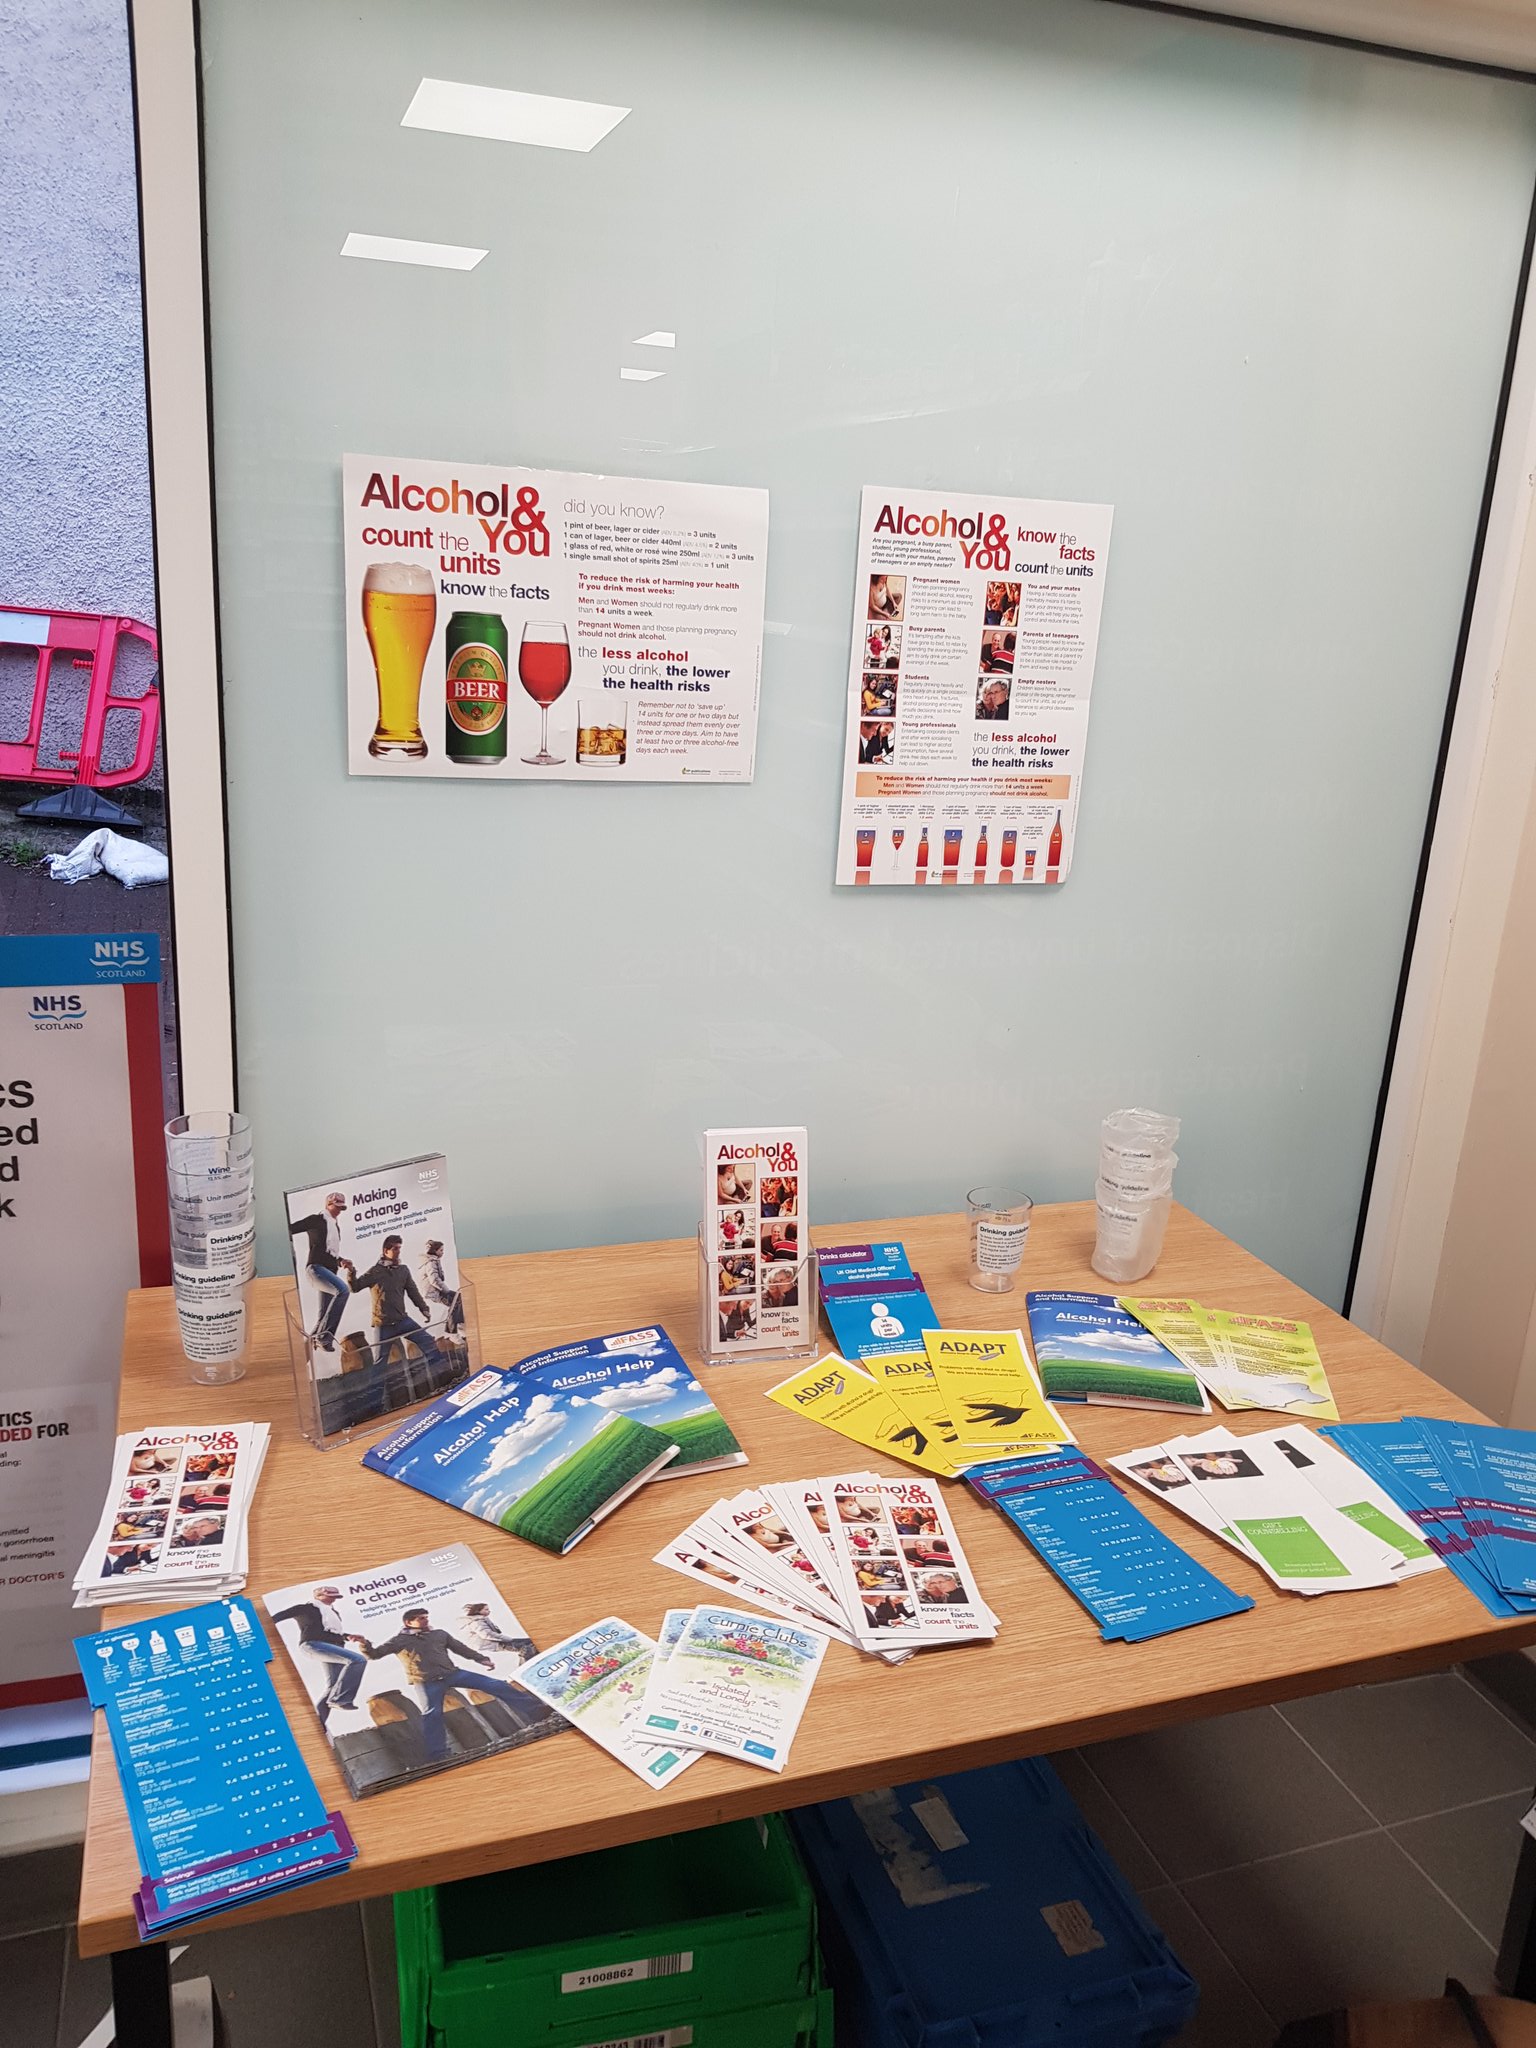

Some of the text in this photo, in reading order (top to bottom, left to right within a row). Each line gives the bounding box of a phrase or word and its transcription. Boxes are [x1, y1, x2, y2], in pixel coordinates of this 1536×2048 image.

[361, 473, 550, 533] Alcohol &
[564, 499, 665, 519] did you know?
[570, 523, 583, 532] pint
[586, 524, 593, 532] of
[595, 526, 612, 534] beer,
[614, 527, 631, 536] lager
[643, 528, 659, 537] cider
[700, 533, 717, 541] units
[874, 505, 1010, 551] Alcohol &
[1017, 526, 1077, 546] know the
[362, 527, 469, 552] count the
[478, 518, 550, 556] You
[959, 541, 1011, 571] You
[1059, 545, 1095, 561] facts
[440, 552, 501, 575] units
[1015, 562, 1094, 577] count the units
[441, 580, 549, 600] know the facts
[579, 573, 740, 590] To reduce the risk of harming your health
[586, 584, 600, 592] you
[603, 584, 623, 592] drink
[626, 585, 645, 593] most
[648, 587, 675, 595] weeks:
[578, 646, 689, 662] the less alcohol
[603, 663, 731, 678] you drink, the lower
[454, 681, 500, 699] BEER
[603, 677, 710, 692] the health risks
[974, 732, 1057, 744] the less alcohol
[972, 745, 1070, 757] you drink, the lower
[972, 758, 1054, 769] the health risks
[94, 941, 145, 958] NHS
[96, 970, 146, 978] SCOTLAND
[33, 995, 82, 1012] NHS
[34, 1022, 83, 1031] SCOTLAND
[717, 1142, 796, 1162] Alcohol &
[208, 1165, 231, 1175] Wine
[767, 1157, 798, 1173] You
[419, 1169, 438, 1179] NHS
[352, 1188, 397, 1206] Making
[354, 1201, 409, 1222] a change
[355, 1206, 442, 1232] Helping you make positive choices
[356, 1232, 372, 1240] about
[383, 1223, 403, 1232] amount
[404, 1221, 413, 1229] you
[414, 1217, 427, 1225] drink
[979, 1225, 1007, 1236] Drinking
[210, 1233, 243, 1245] Drinking
[198, 1274, 236, 1284] guideline
[206, 1309, 243, 1322] guideline
[761, 1310, 780, 1318] know
[1055, 1312, 1145, 1329] Alcohol Hel
[761, 1325, 781, 1333] count
[1250, 1318, 1298, 1331] FASS
[620, 1331, 655, 1344] FASS
[940, 1341, 1007, 1355] ADAPT
[519, 1345, 589, 1371] Alcohol Support
[521, 1349, 589, 1375] and Information
[552, 1360, 655, 1389] Alcohol Help
[462, 1373, 493, 1401] FASS
[793, 1370, 848, 1404] ADAPT
[36, 1422, 70, 1439] FOR
[377, 1411, 439, 1458] Alcohol Support
[383, 1448, 400, 1461] and
[400, 1414, 444, 1449] Information
[432, 1420, 487, 1464] Alcohol
[483, 1396, 520, 1423] Help
[135, 1431, 237, 1447] Alcohol &
[199, 1440, 239, 1451] You
[833, 1483, 927, 1498] Alcohol &
[898, 1493, 933, 1504] You
[731, 1502, 774, 1526] Alco
[1247, 1527, 1308, 1535] COUNSELLING
[4, 1536, 54, 1548] gonorrhoea
[10, 1550, 55, 1561] meningitis
[430, 1552, 455, 1564] NHS
[9, 1571, 65, 1585] DOCTOR'S
[348, 1574, 408, 1595] Making
[355, 1581, 427, 1606] a change
[708, 1615, 808, 1649] Curnie Clubs
[536, 1627, 620, 1679] Curnie Clubs
[699, 1688, 757, 1707] and Lonely?
[712, 1682, 751, 1698] Isolated
[578, 1968, 634, 1985] 21008862
